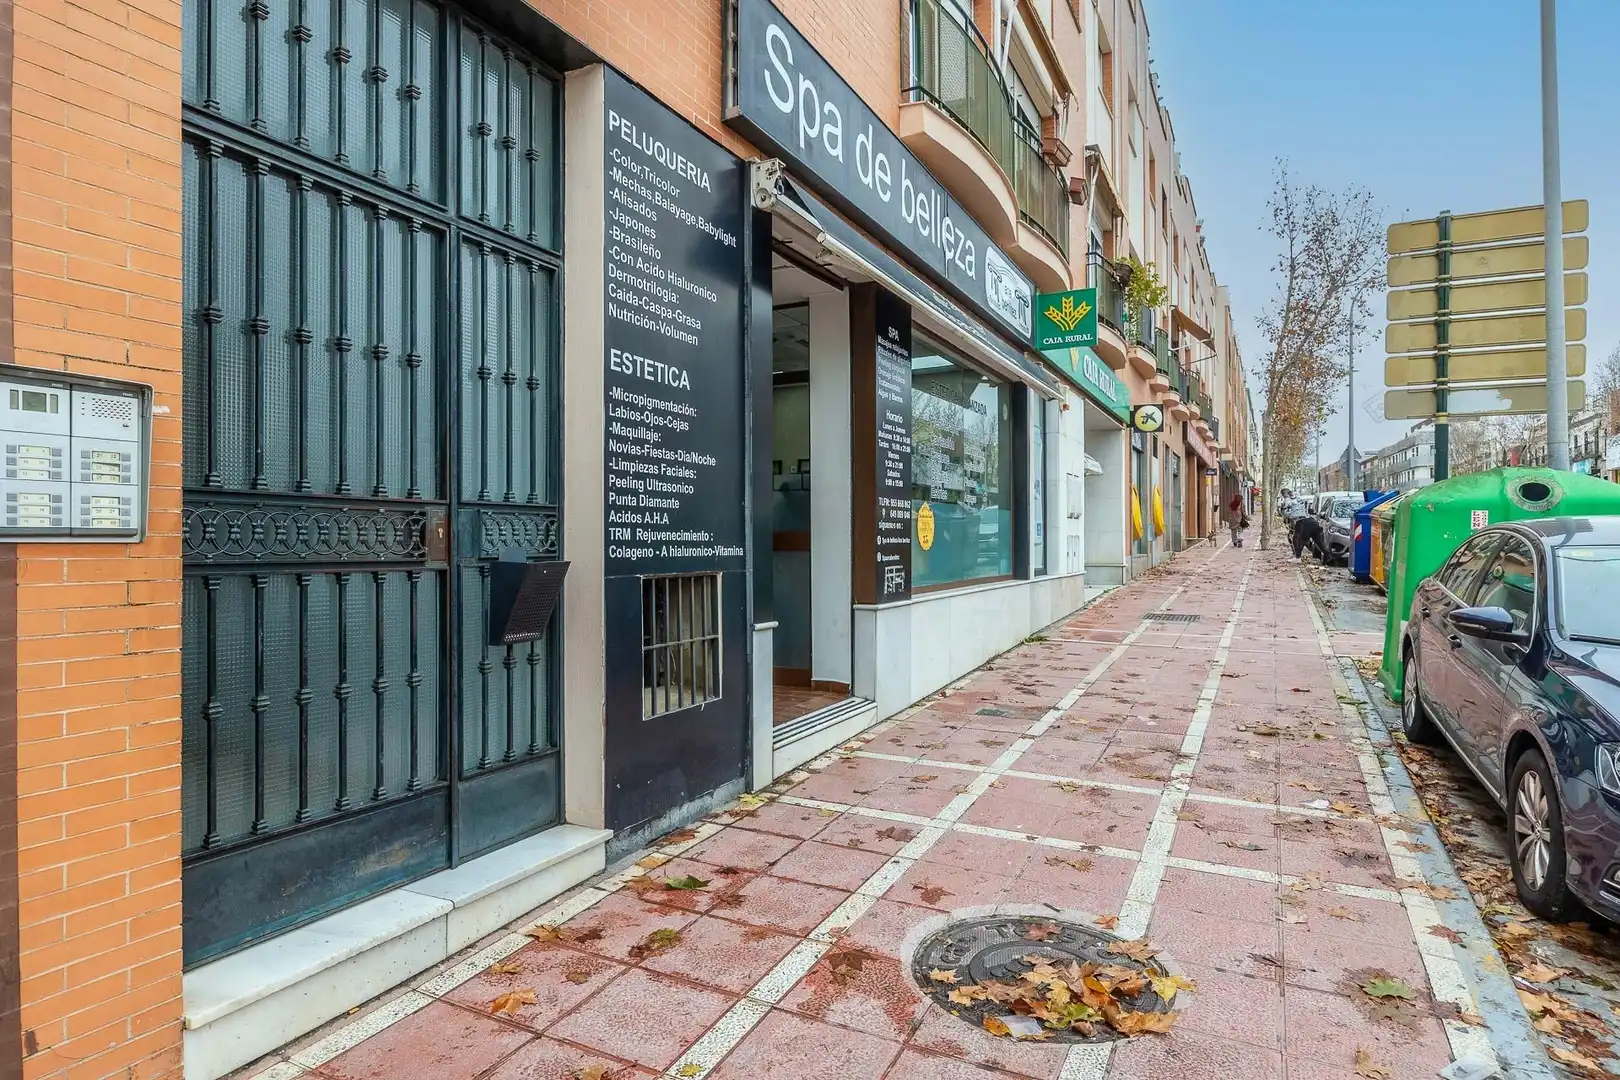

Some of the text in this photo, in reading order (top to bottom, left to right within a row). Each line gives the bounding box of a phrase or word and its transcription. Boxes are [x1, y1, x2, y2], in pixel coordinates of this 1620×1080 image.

[609, 110, 711, 192] PELUQUERIA
[764, 23, 976, 281] Spa de belleza
[609, 149, 680, 198] -Color,Tricolor
[609, 189, 657, 221] -Alisados
[609, 209, 656, 239] -Japones
[609, 229, 661, 260] -Brasileño
[636, 258, 665, 279] Acido
[668, 269, 717, 302] Hialuronico
[609, 283, 701, 330] Caida-Caspa-Grasa
[609, 303, 698, 346] Nutrición-Volumen
[888, 326, 899, 341] SPA
[1065, 334, 1093, 342] RURAL
[610, 349, 691, 390] ESTETICA
[609, 404, 689, 432] Labios-Ojos-Cejas
[886, 409, 903, 424] Horario
[609, 476, 694, 494] Peeling Ultrasonico
[661, 464, 697, 479] Faciales:
[609, 492, 680, 509] Punta Diamante
[609, 511, 669, 525] Acidos A.H.A
[609, 528, 631, 540] TRM
[609, 545, 654, 558] Colageno
